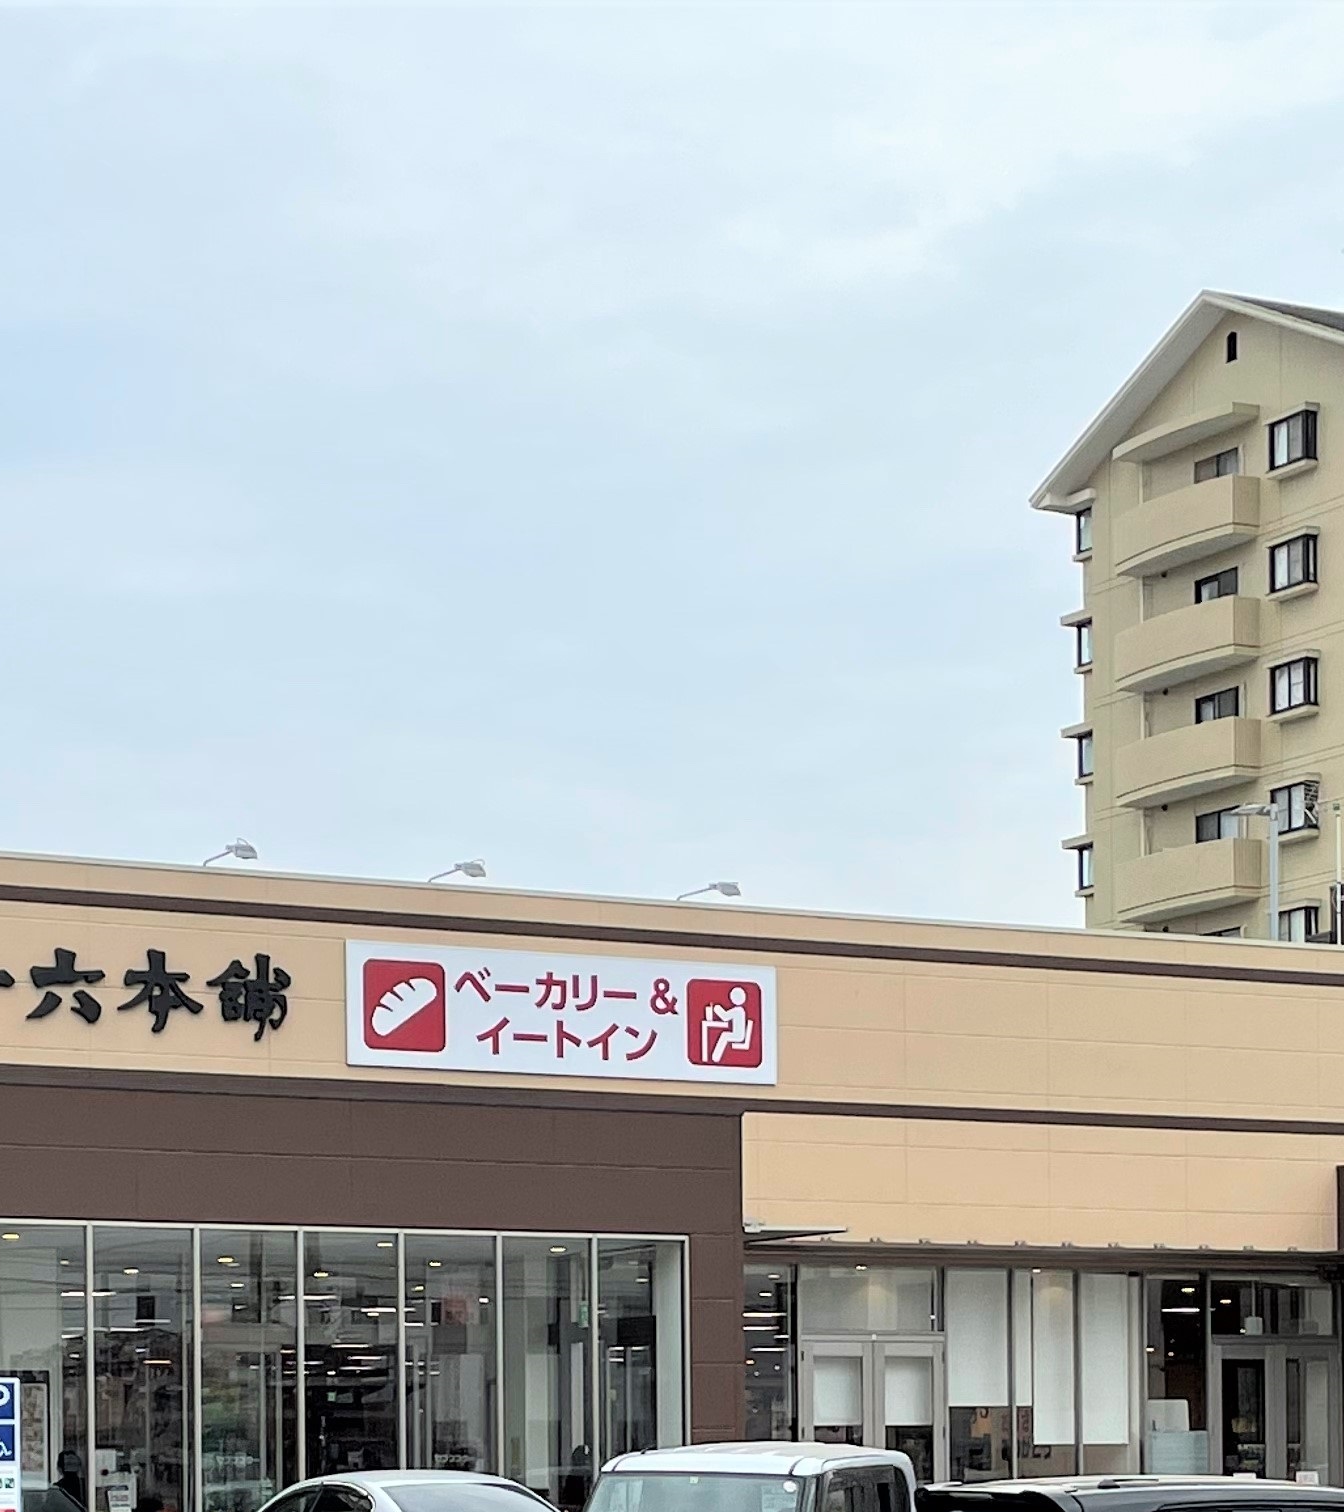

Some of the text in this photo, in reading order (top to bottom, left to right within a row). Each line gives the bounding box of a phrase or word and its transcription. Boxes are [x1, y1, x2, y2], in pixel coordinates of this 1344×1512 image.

[454, 966, 678, 1015] ベーカリー &
[476, 1016, 657, 1061] イートイン
